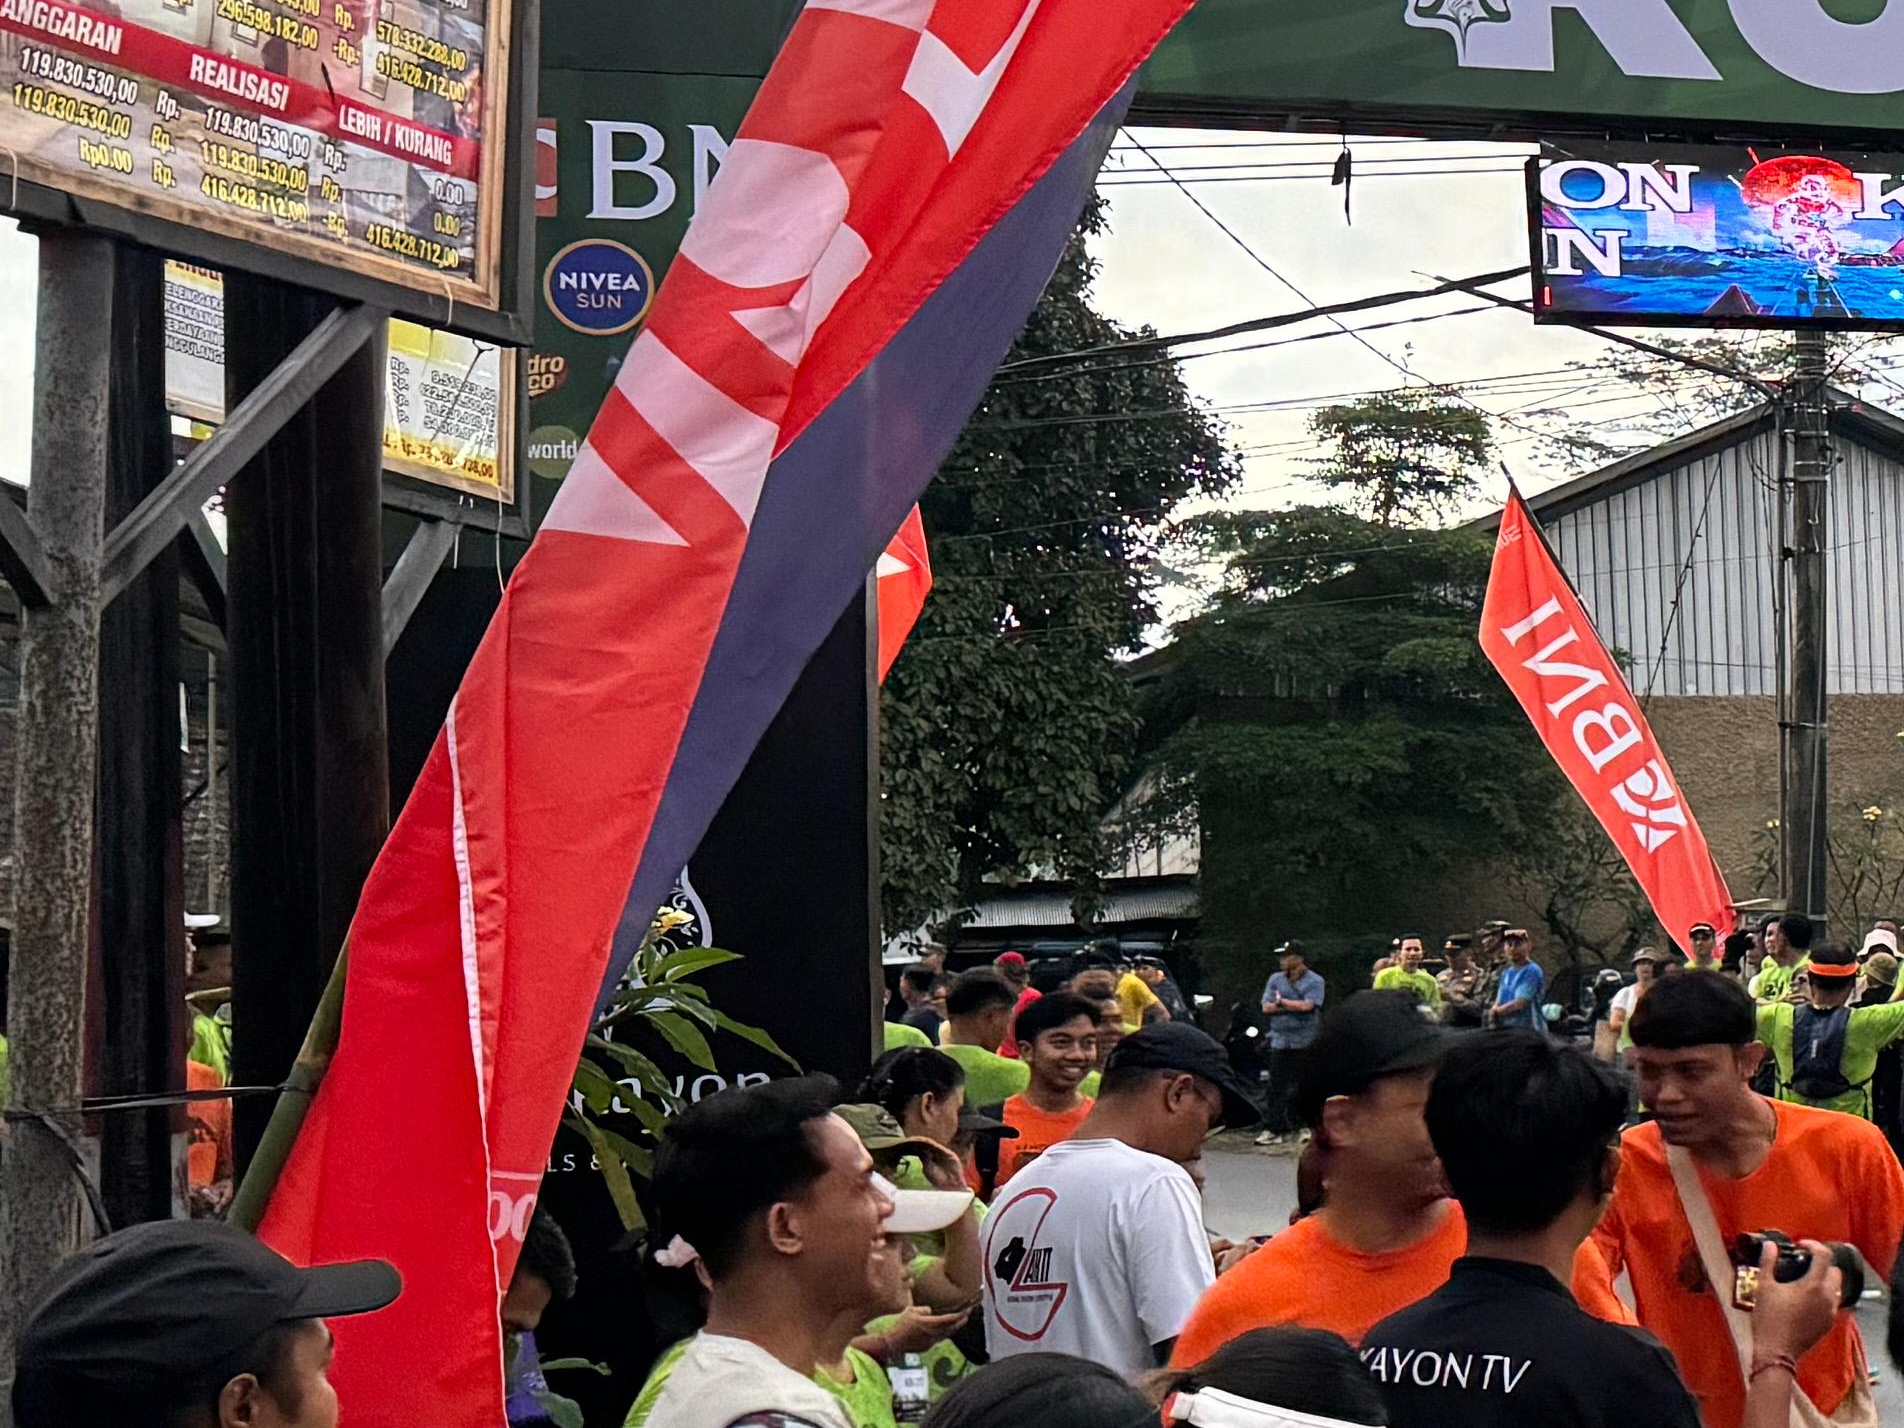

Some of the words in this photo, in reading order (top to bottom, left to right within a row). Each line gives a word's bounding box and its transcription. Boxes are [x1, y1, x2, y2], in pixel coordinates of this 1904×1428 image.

[190, 54, 289, 112] REALISASI
[339, 105, 380, 143] LEBIH
[395, 122, 452, 165] KURANG
[1538, 160, 1700, 213] ON
[559, 272, 641, 292] NIVEA
[576, 293, 622, 309] SUN
[1500, 594, 1643, 774] BNI
[1482, 1354, 1532, 1393] TV
